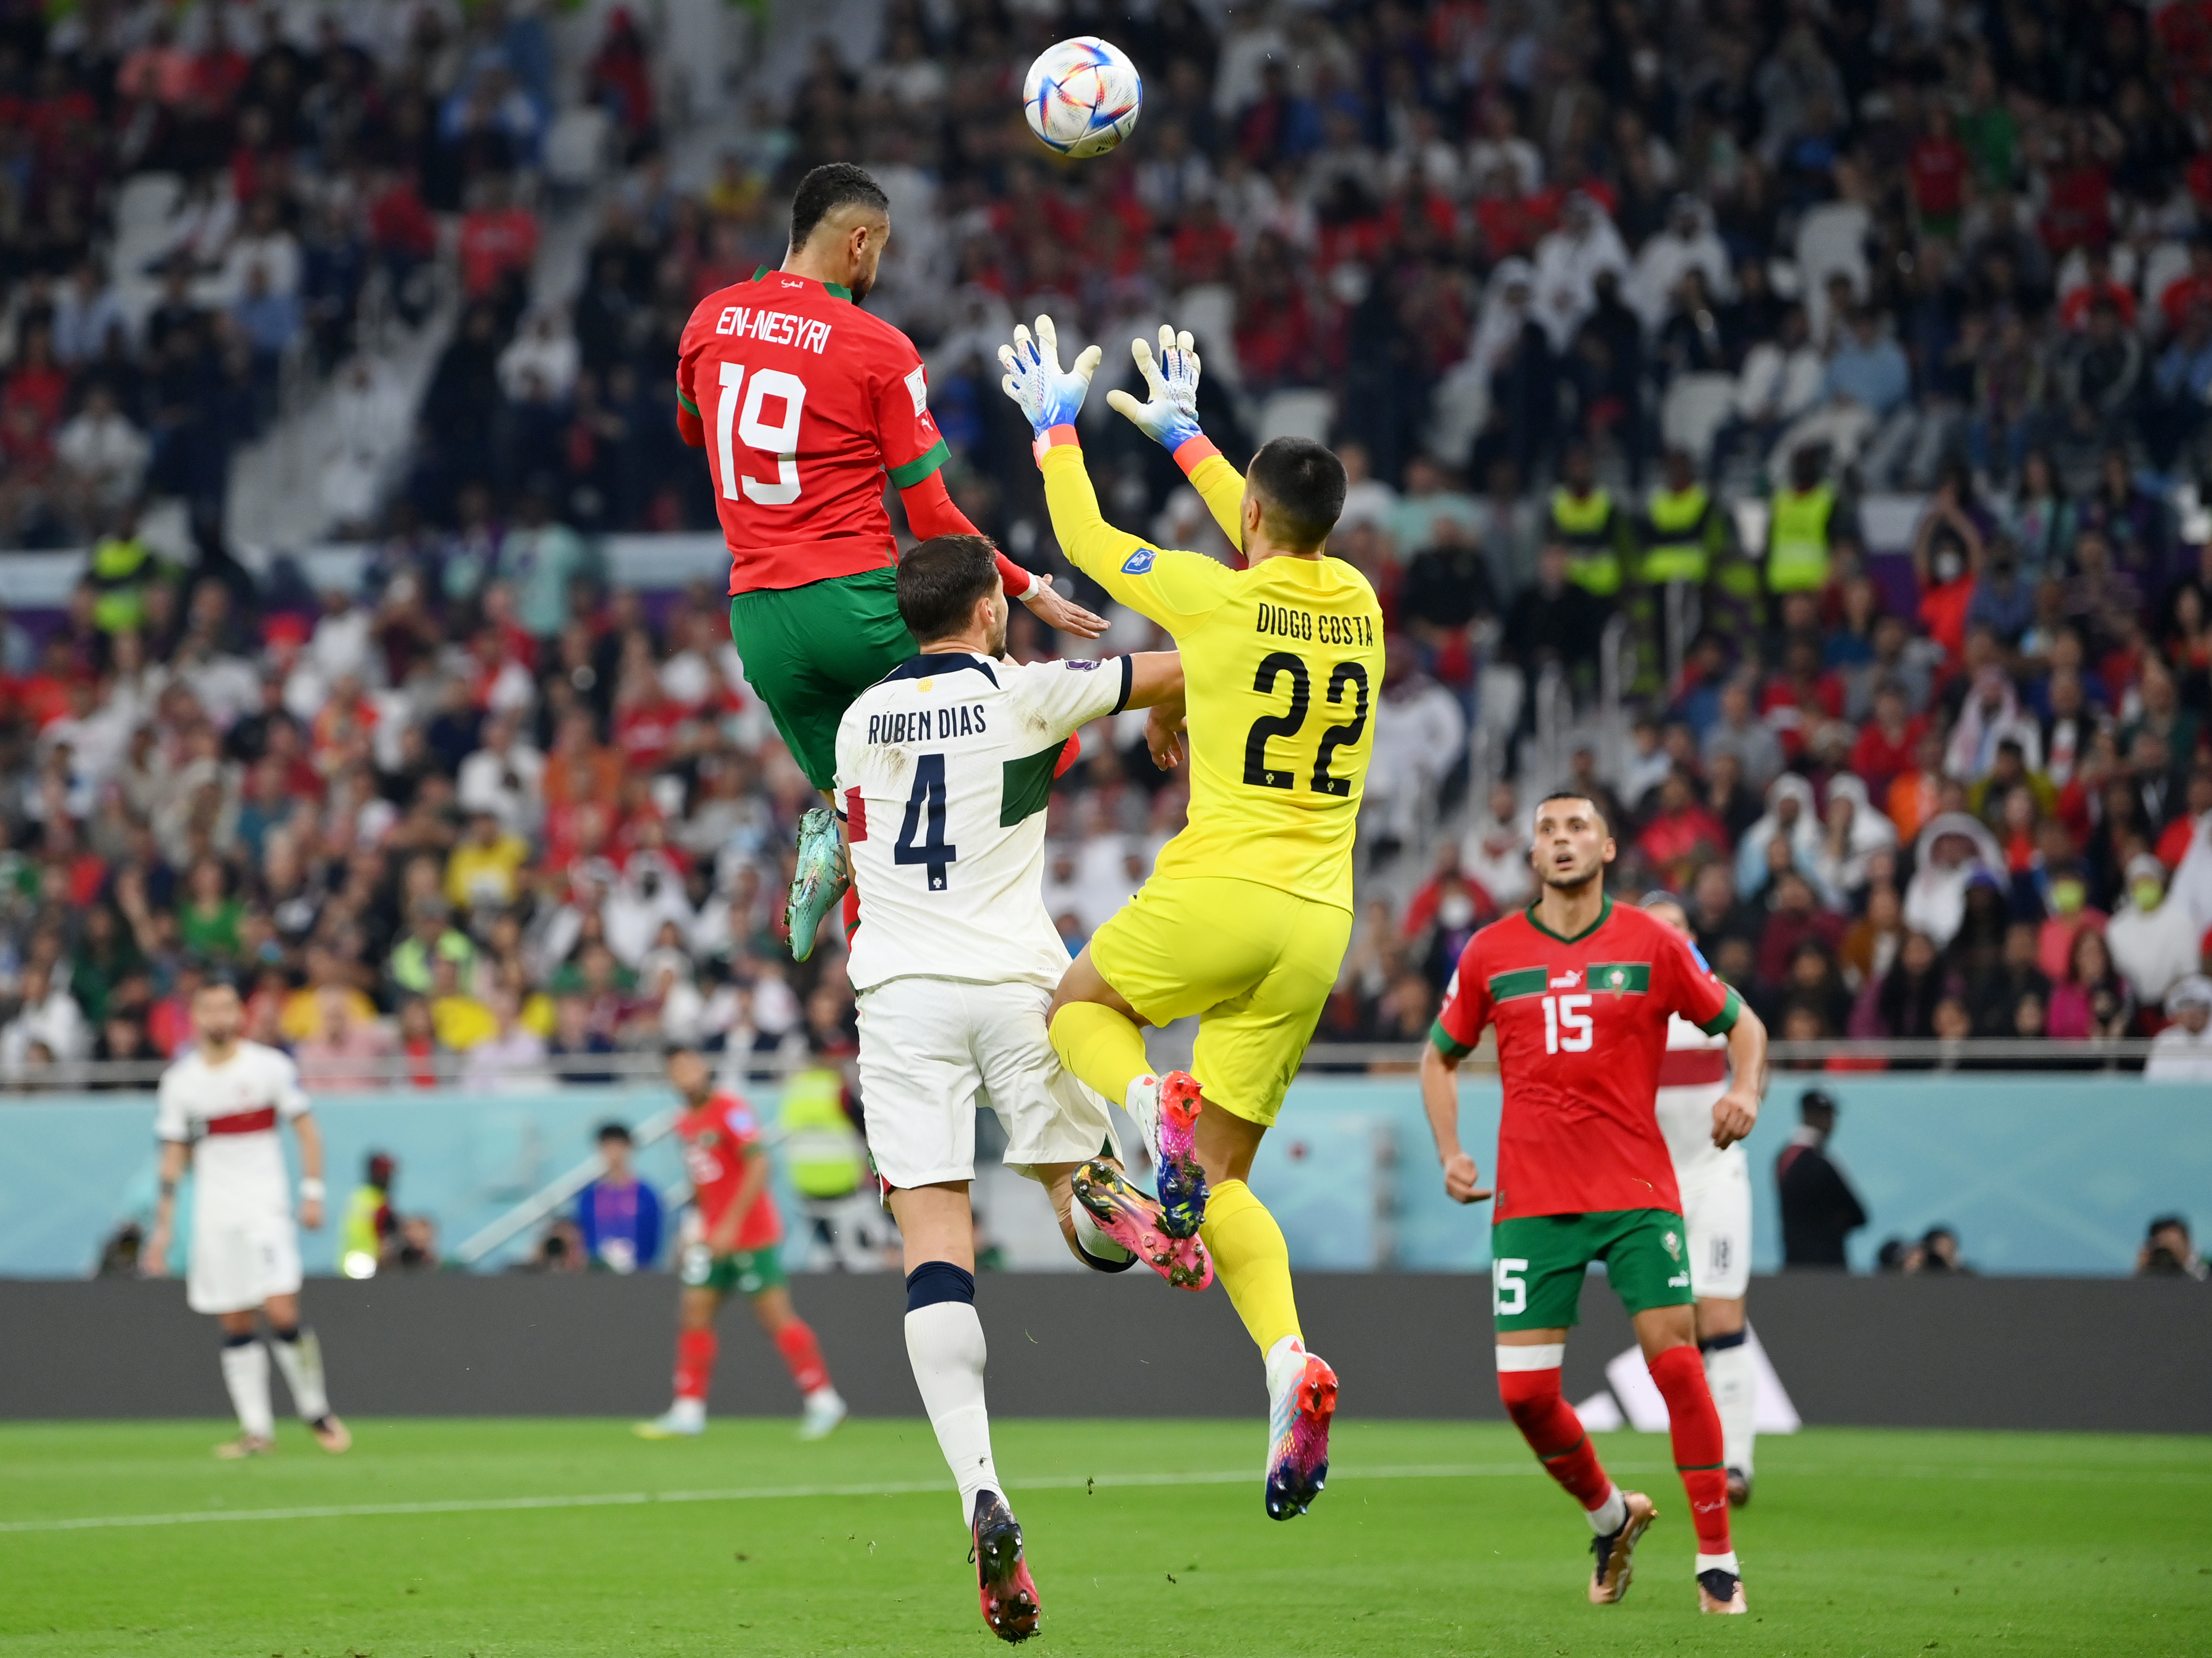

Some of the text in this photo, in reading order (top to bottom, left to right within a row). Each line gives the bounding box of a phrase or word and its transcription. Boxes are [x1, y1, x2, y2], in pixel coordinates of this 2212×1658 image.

[715, 306, 832, 354] EN-NESYRI
[717, 361, 807, 505] 19
[1256, 603, 1374, 647] DIOGO COSTA
[868, 704, 986, 745] RÚBEN DIAS
[1243, 652, 1370, 797] 22
[894, 753, 956, 891] 4
[1541, 994, 1594, 1054] 15
